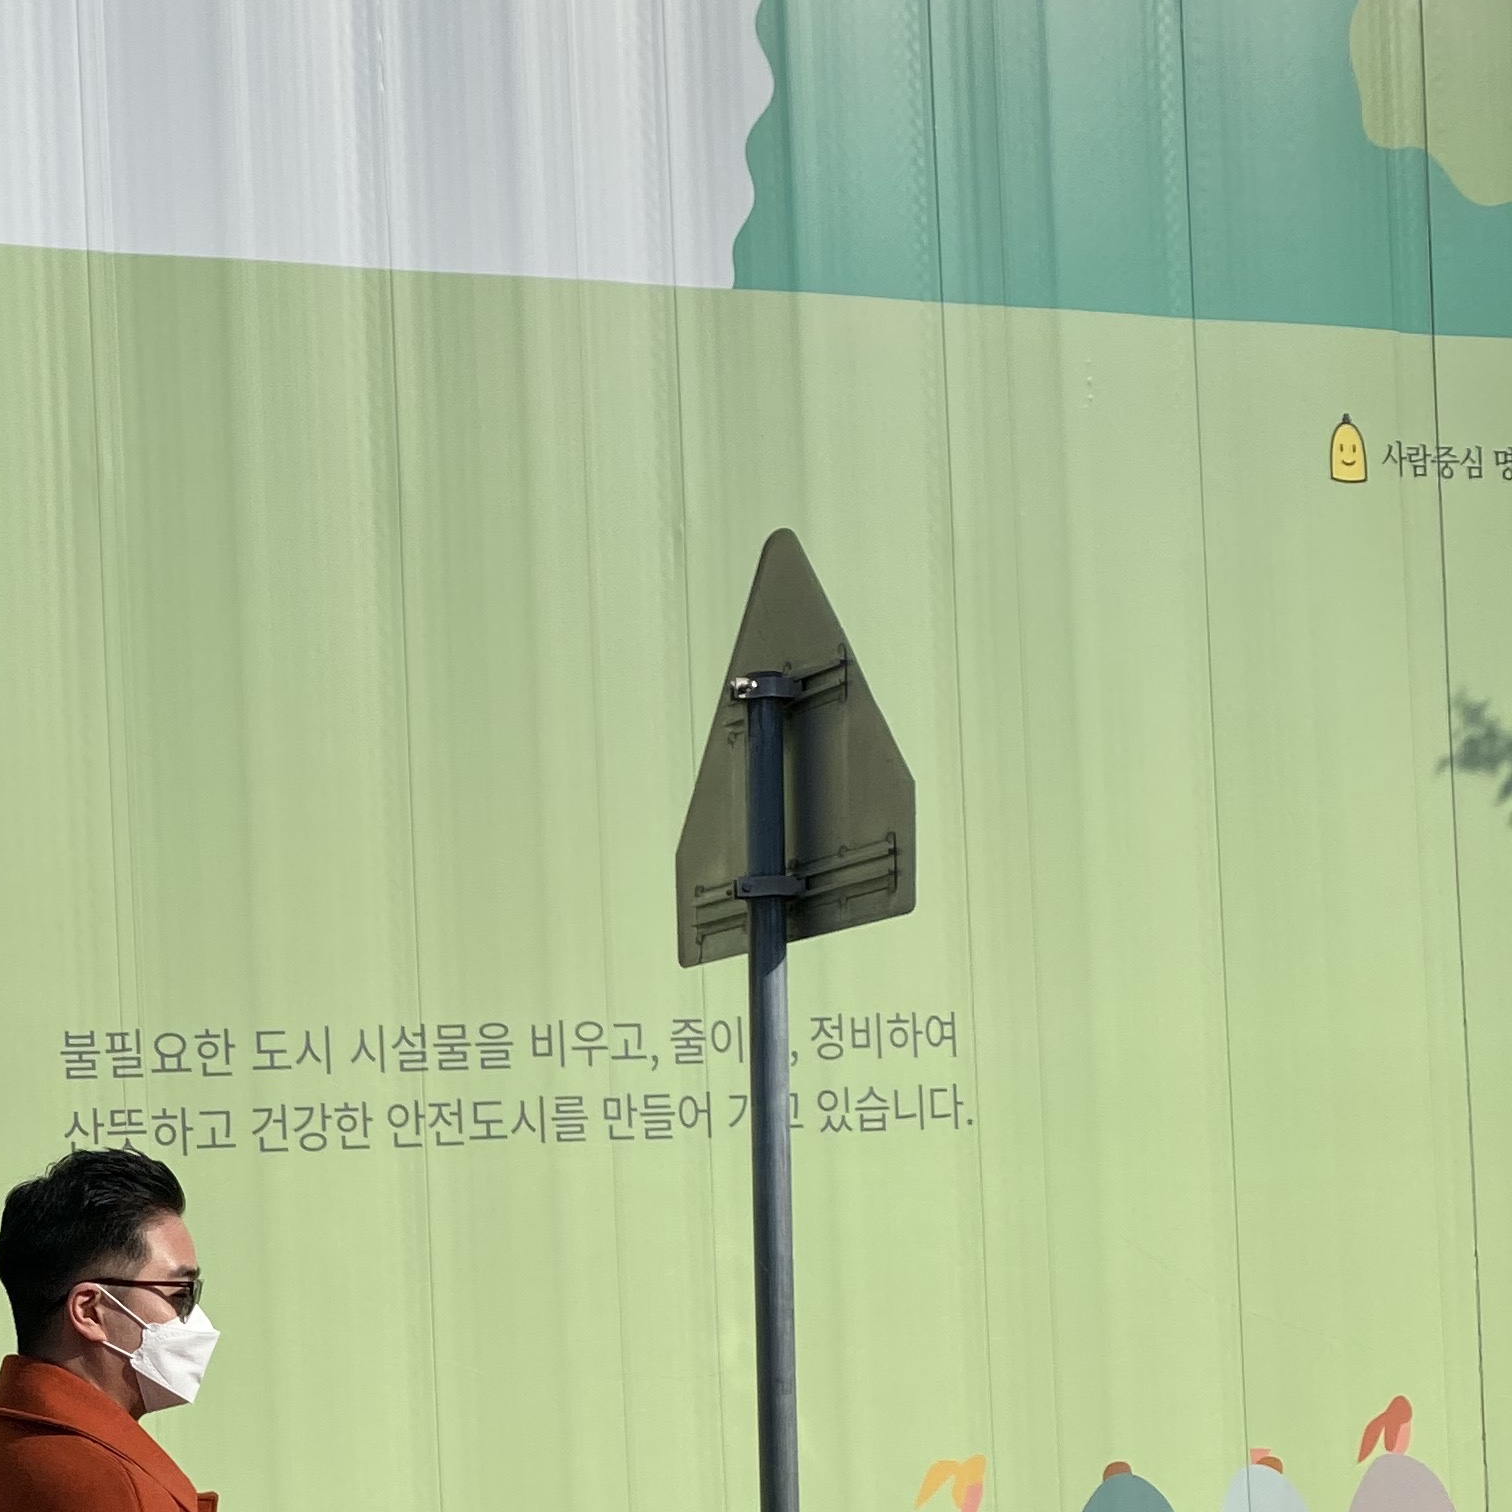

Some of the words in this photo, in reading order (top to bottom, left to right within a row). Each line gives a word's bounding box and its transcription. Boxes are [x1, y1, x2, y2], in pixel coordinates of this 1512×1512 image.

[1382, 440, 1484, 480] 사람중심
[60, 1027, 236, 1079] 불필요한
[252, 1026, 332, 1074] 도시
[350, 1022, 514, 1073] 시설물을
[531, 1018, 659, 1071] 비우고,
[670, 1016, 798, 1066] 줄이,
[810, 1011, 957, 1060] 정비하여
[64, 1107, 237, 1156] 산뜻하고
[252, 1101, 373, 1152] 건강한
[387, 1096, 588, 1148] 안전도시를
[603, 1091, 712, 1140] 만들어
[817, 1083, 974, 1133] 있습니다.
